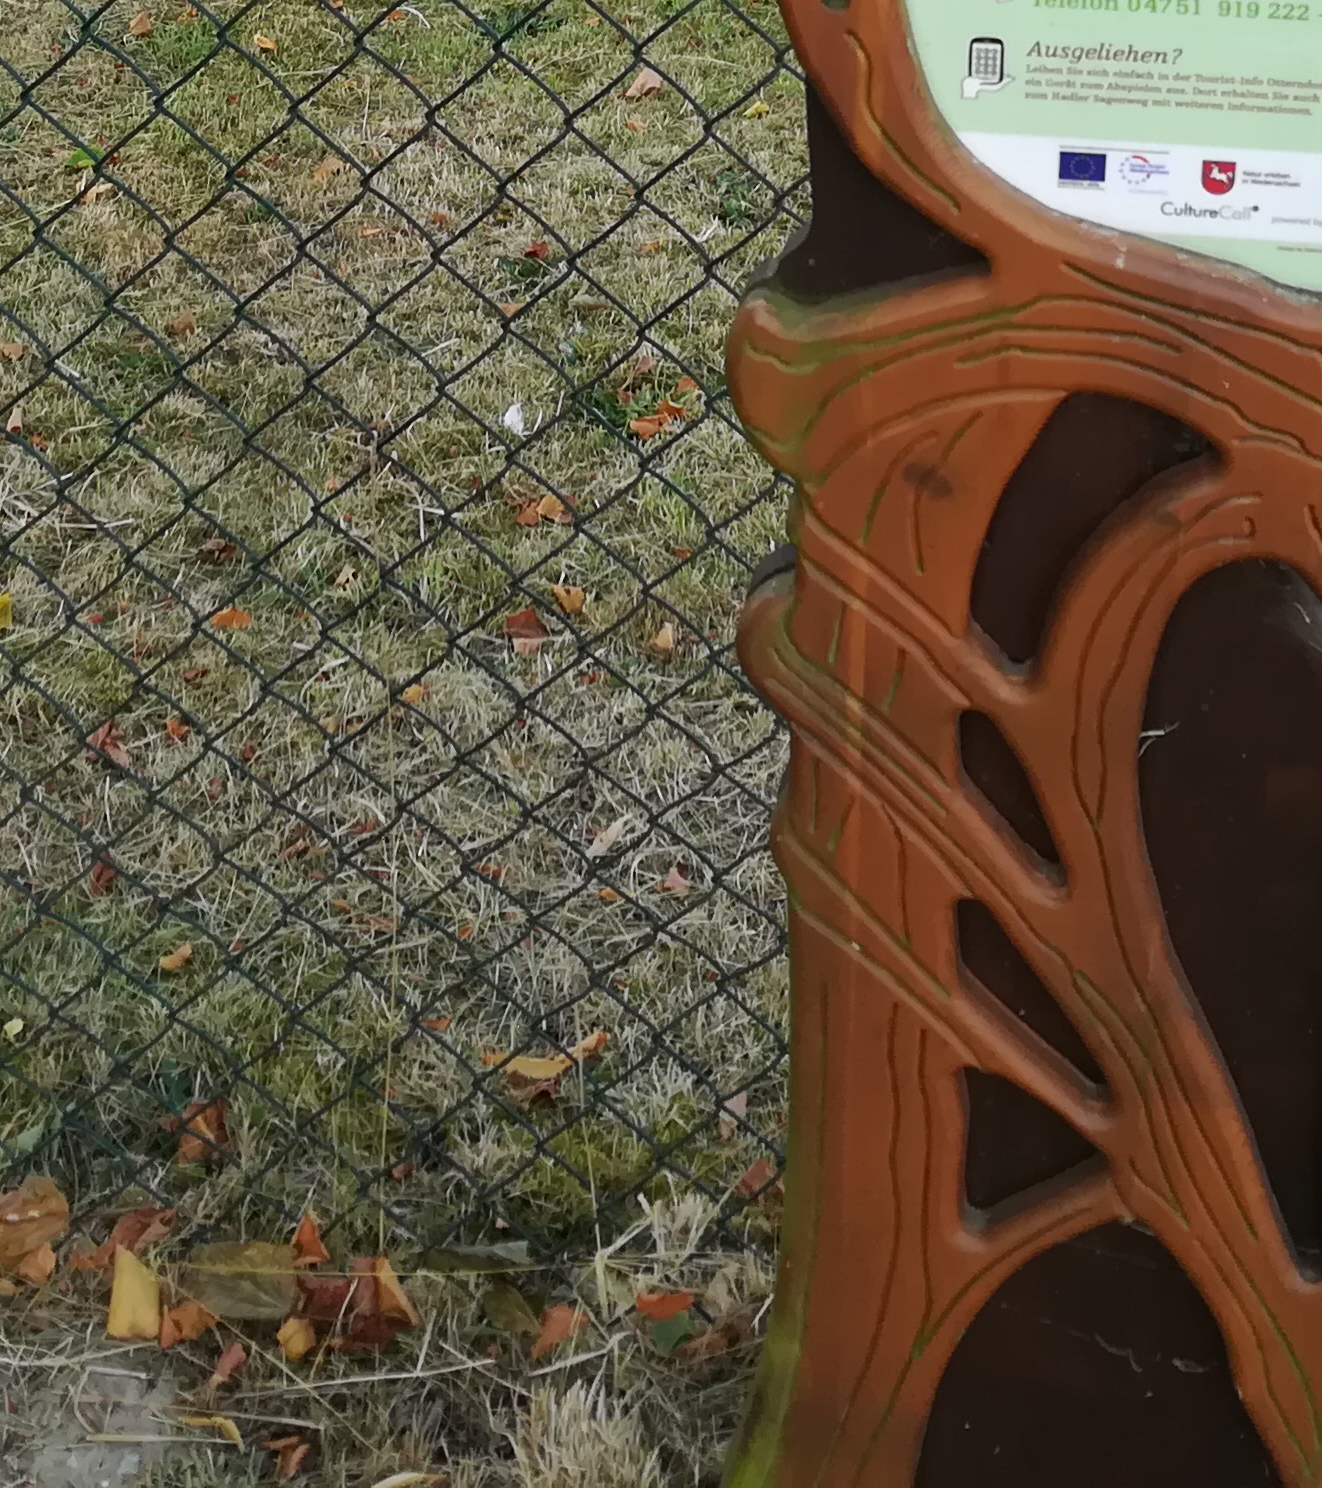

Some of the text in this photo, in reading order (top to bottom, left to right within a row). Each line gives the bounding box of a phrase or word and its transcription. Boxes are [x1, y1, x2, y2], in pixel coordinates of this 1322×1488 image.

[1218, 0, 1260, 19] 919
[1267, 3, 1310, 22] 222
[1026, 40, 1184, 65] Ausgeliehen?
[1066, 67, 1083, 77] Sie
[1172, 73, 1191, 83] der
